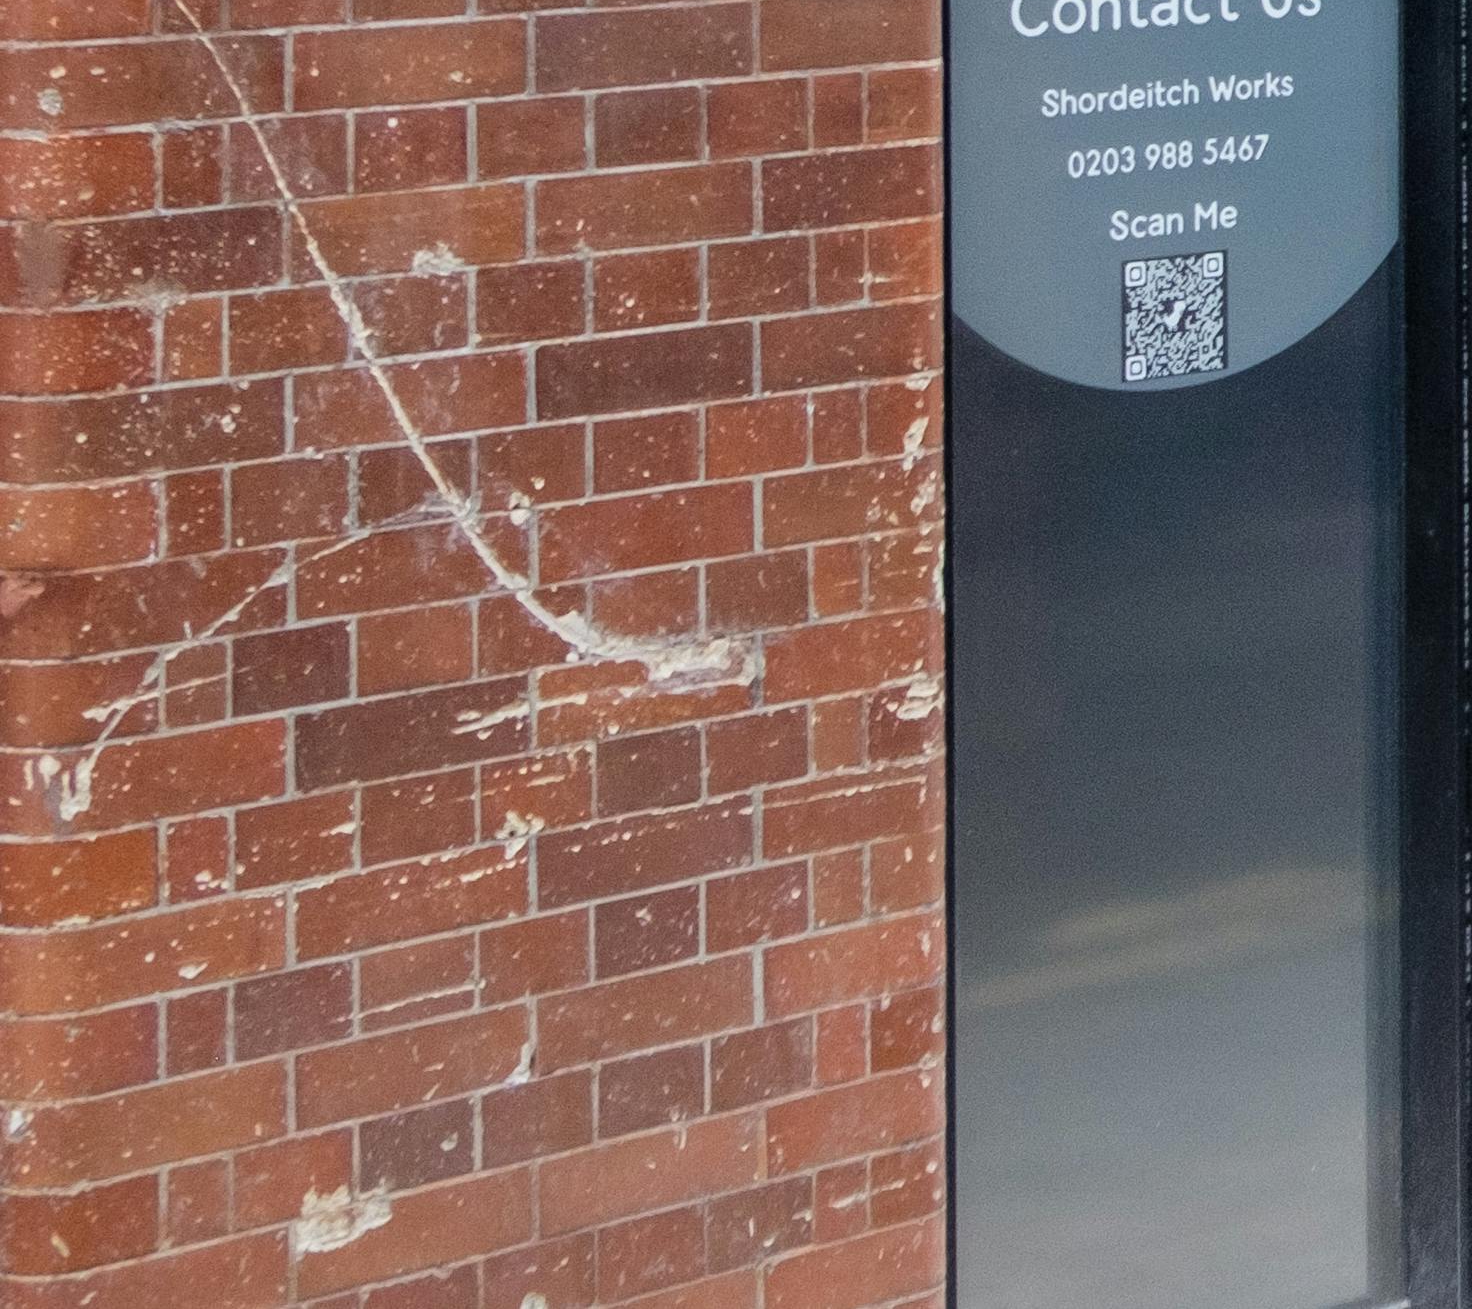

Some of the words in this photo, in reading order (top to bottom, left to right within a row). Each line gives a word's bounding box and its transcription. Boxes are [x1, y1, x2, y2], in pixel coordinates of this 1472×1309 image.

[1041, 80, 1199, 118] Shordeitch
[1209, 72, 1295, 103] Works
[1067, 145, 1136, 179] 0203
[1145, 140, 1194, 172] 988
[1202, 134, 1269, 165] 5467
[1109, 208, 1184, 241] Scan
[1195, 201, 1238, 233] Me
